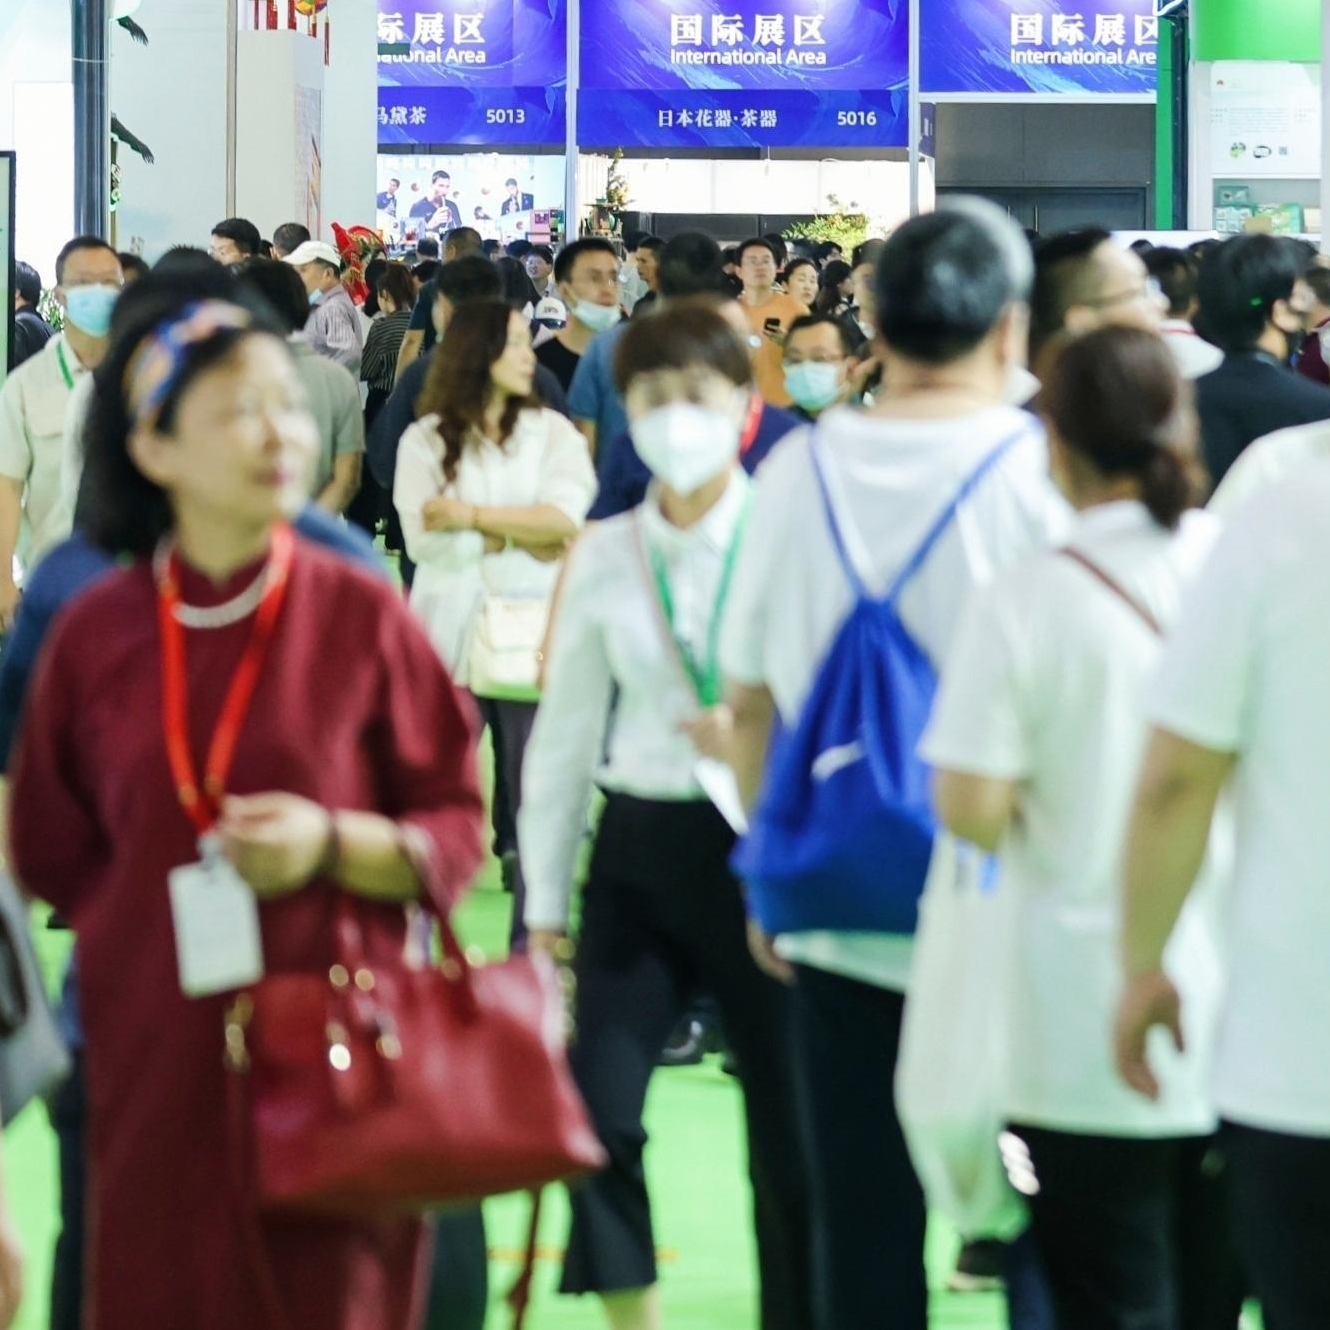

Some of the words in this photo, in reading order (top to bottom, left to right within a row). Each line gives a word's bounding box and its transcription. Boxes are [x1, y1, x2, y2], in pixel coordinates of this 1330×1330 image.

[671, 13, 826, 46] 国际展区
[1010, 13, 1158, 46] 国际展区
[445, 48, 486, 63] Area
[671, 47, 782, 65] International
[785, 49, 826, 65] Area
[1010, 47, 1122, 65] International
[1125, 49, 1157, 65] Are
[486, 108, 526, 124] 5013
[837, 111, 877, 126] 5016
